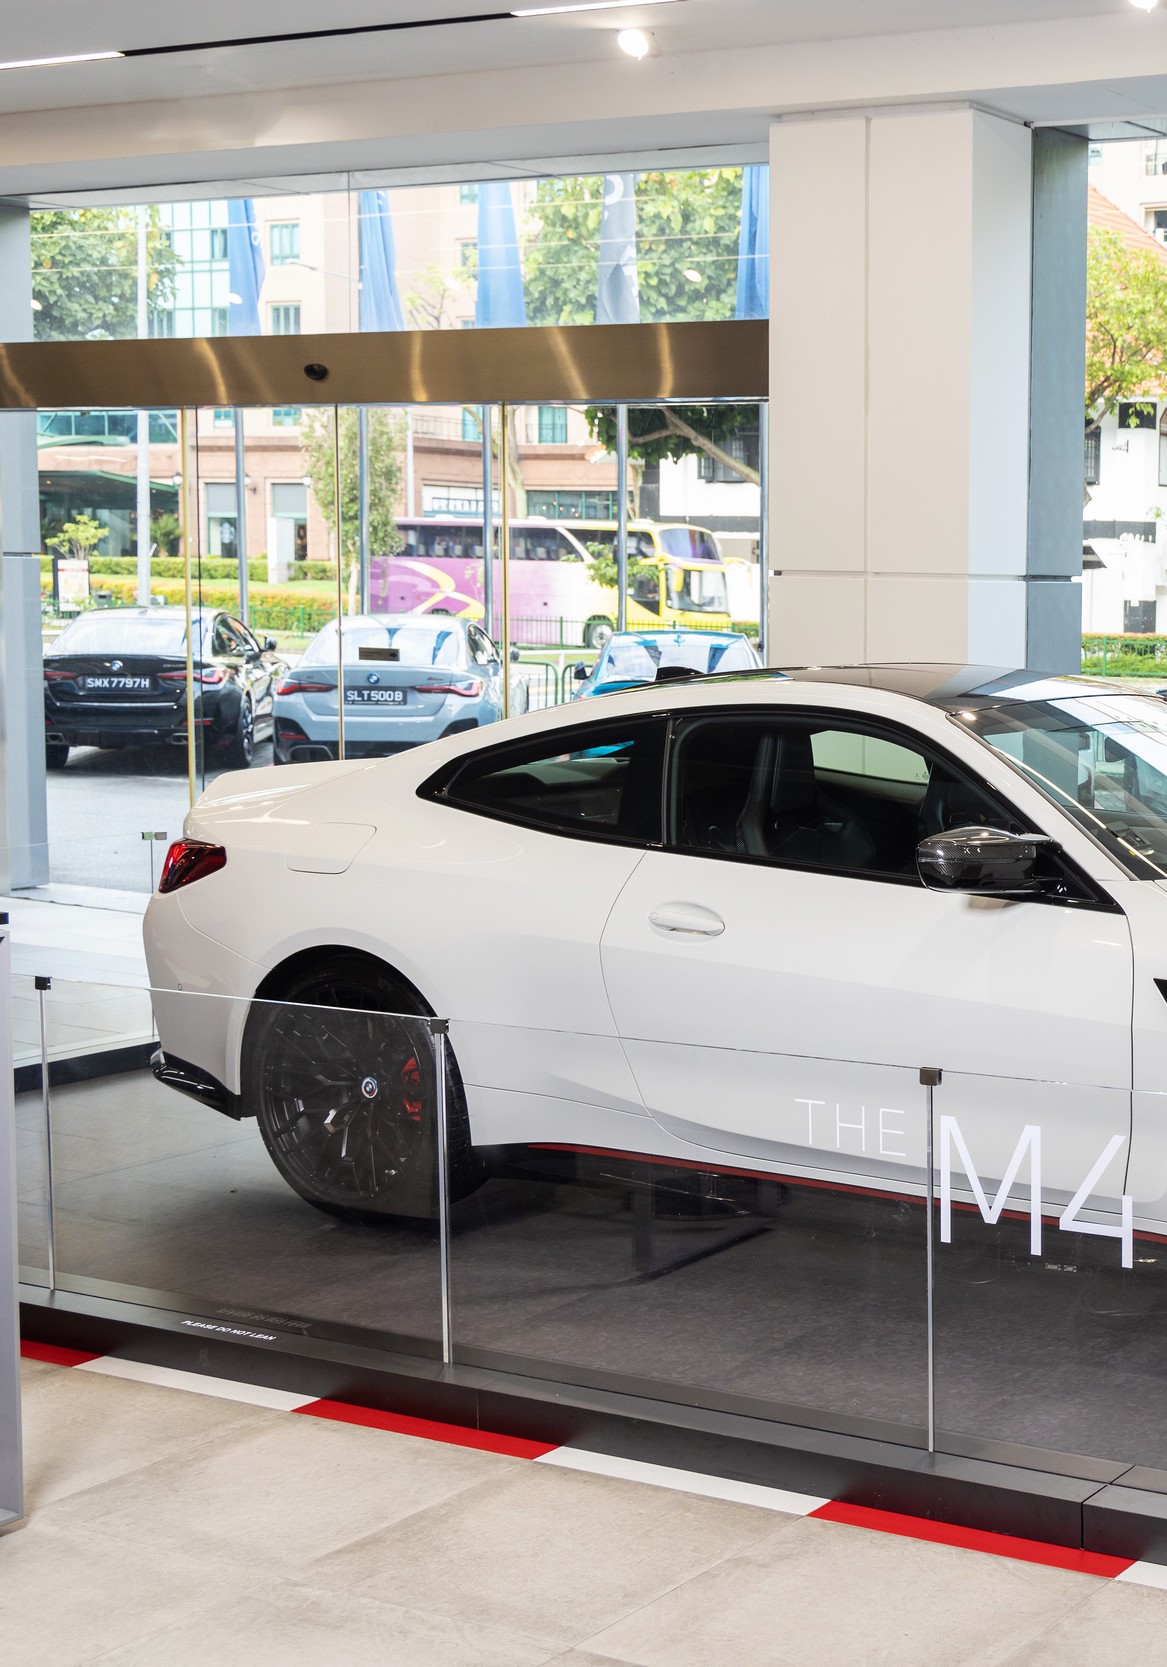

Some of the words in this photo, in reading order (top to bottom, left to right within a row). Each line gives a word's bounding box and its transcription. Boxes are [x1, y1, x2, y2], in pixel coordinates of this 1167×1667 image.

[794, 1098, 907, 1157] THE
[939, 1115, 1133, 1269] M4
[181, 1319, 218, 1330] PLEASE
[230, 1328, 252, 1337] NOT
[249, 1332, 277, 1341] LEAN
